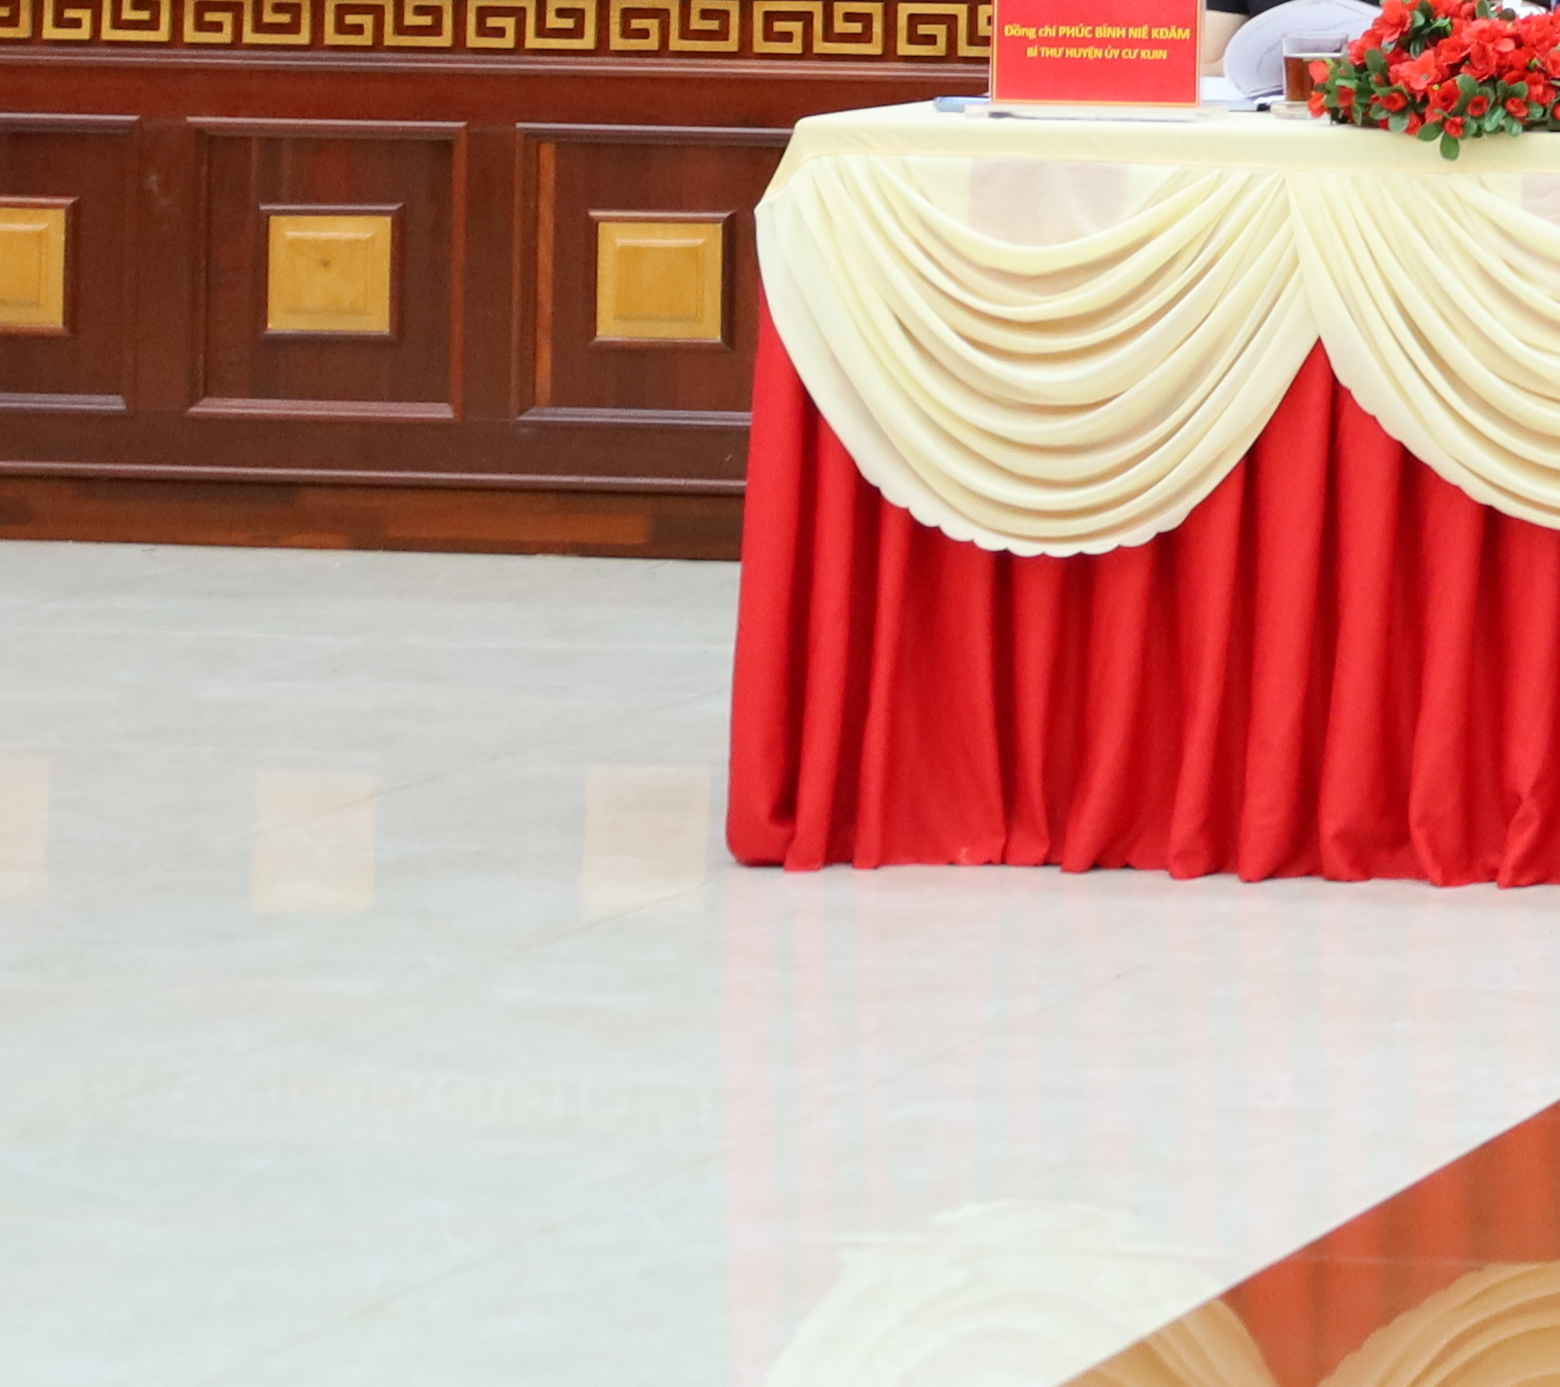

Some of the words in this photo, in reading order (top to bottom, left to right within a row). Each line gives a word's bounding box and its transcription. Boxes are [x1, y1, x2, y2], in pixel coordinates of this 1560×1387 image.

[1004, 24, 1036, 39] Đồng
[1038, 24, 1056, 37] chí
[1058, 23, 1093, 38] PHÚC
[1095, 23, 1126, 38] BÌNH
[1027, 44, 1037, 57] BÍ
[1041, 46, 1065, 58] THƯ
[1065, 46, 1102, 61] HUYỆN
[1121, 48, 1138, 59] CƯ
[1140, 49, 1168, 60] KUIN
